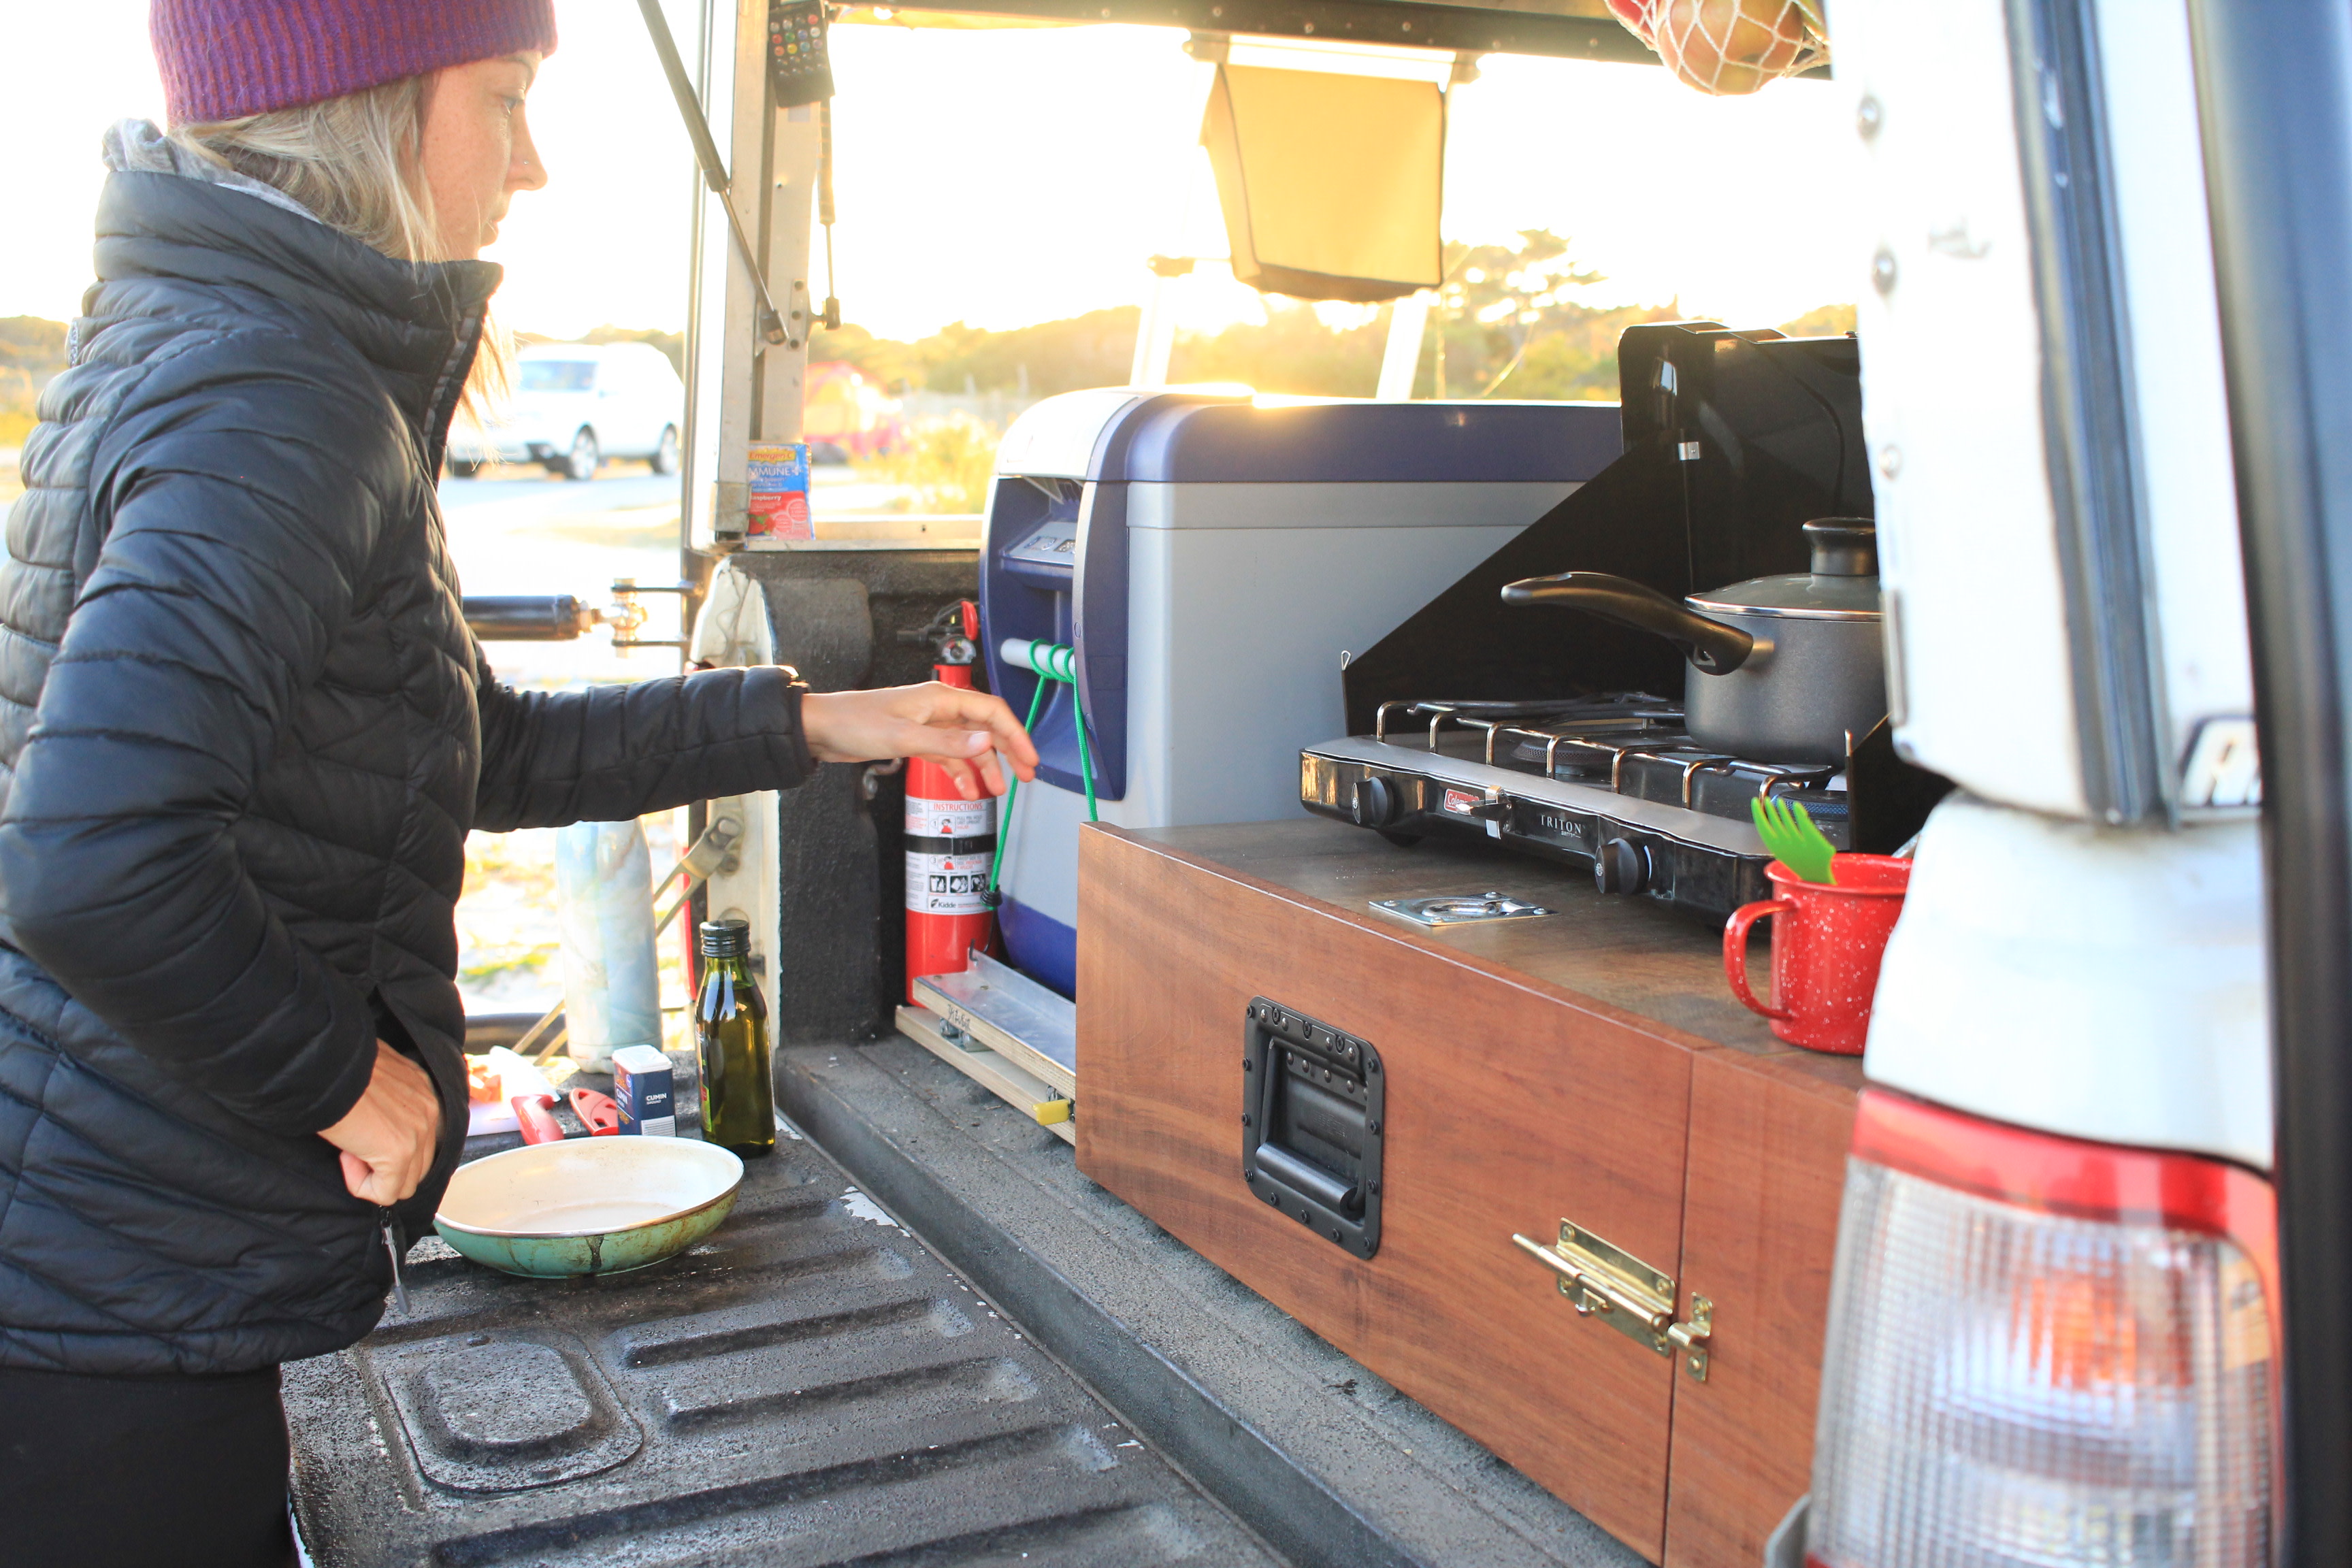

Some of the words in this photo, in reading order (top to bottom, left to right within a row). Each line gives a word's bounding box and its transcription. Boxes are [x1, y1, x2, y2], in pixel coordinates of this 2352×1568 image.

[749, 467, 800, 476] MMUNE+
[934, 802, 983, 811] INSTRUCTIONS
[1541, 814, 1582, 834] TRITON
[647, 1093, 667, 1101] CUMIN
